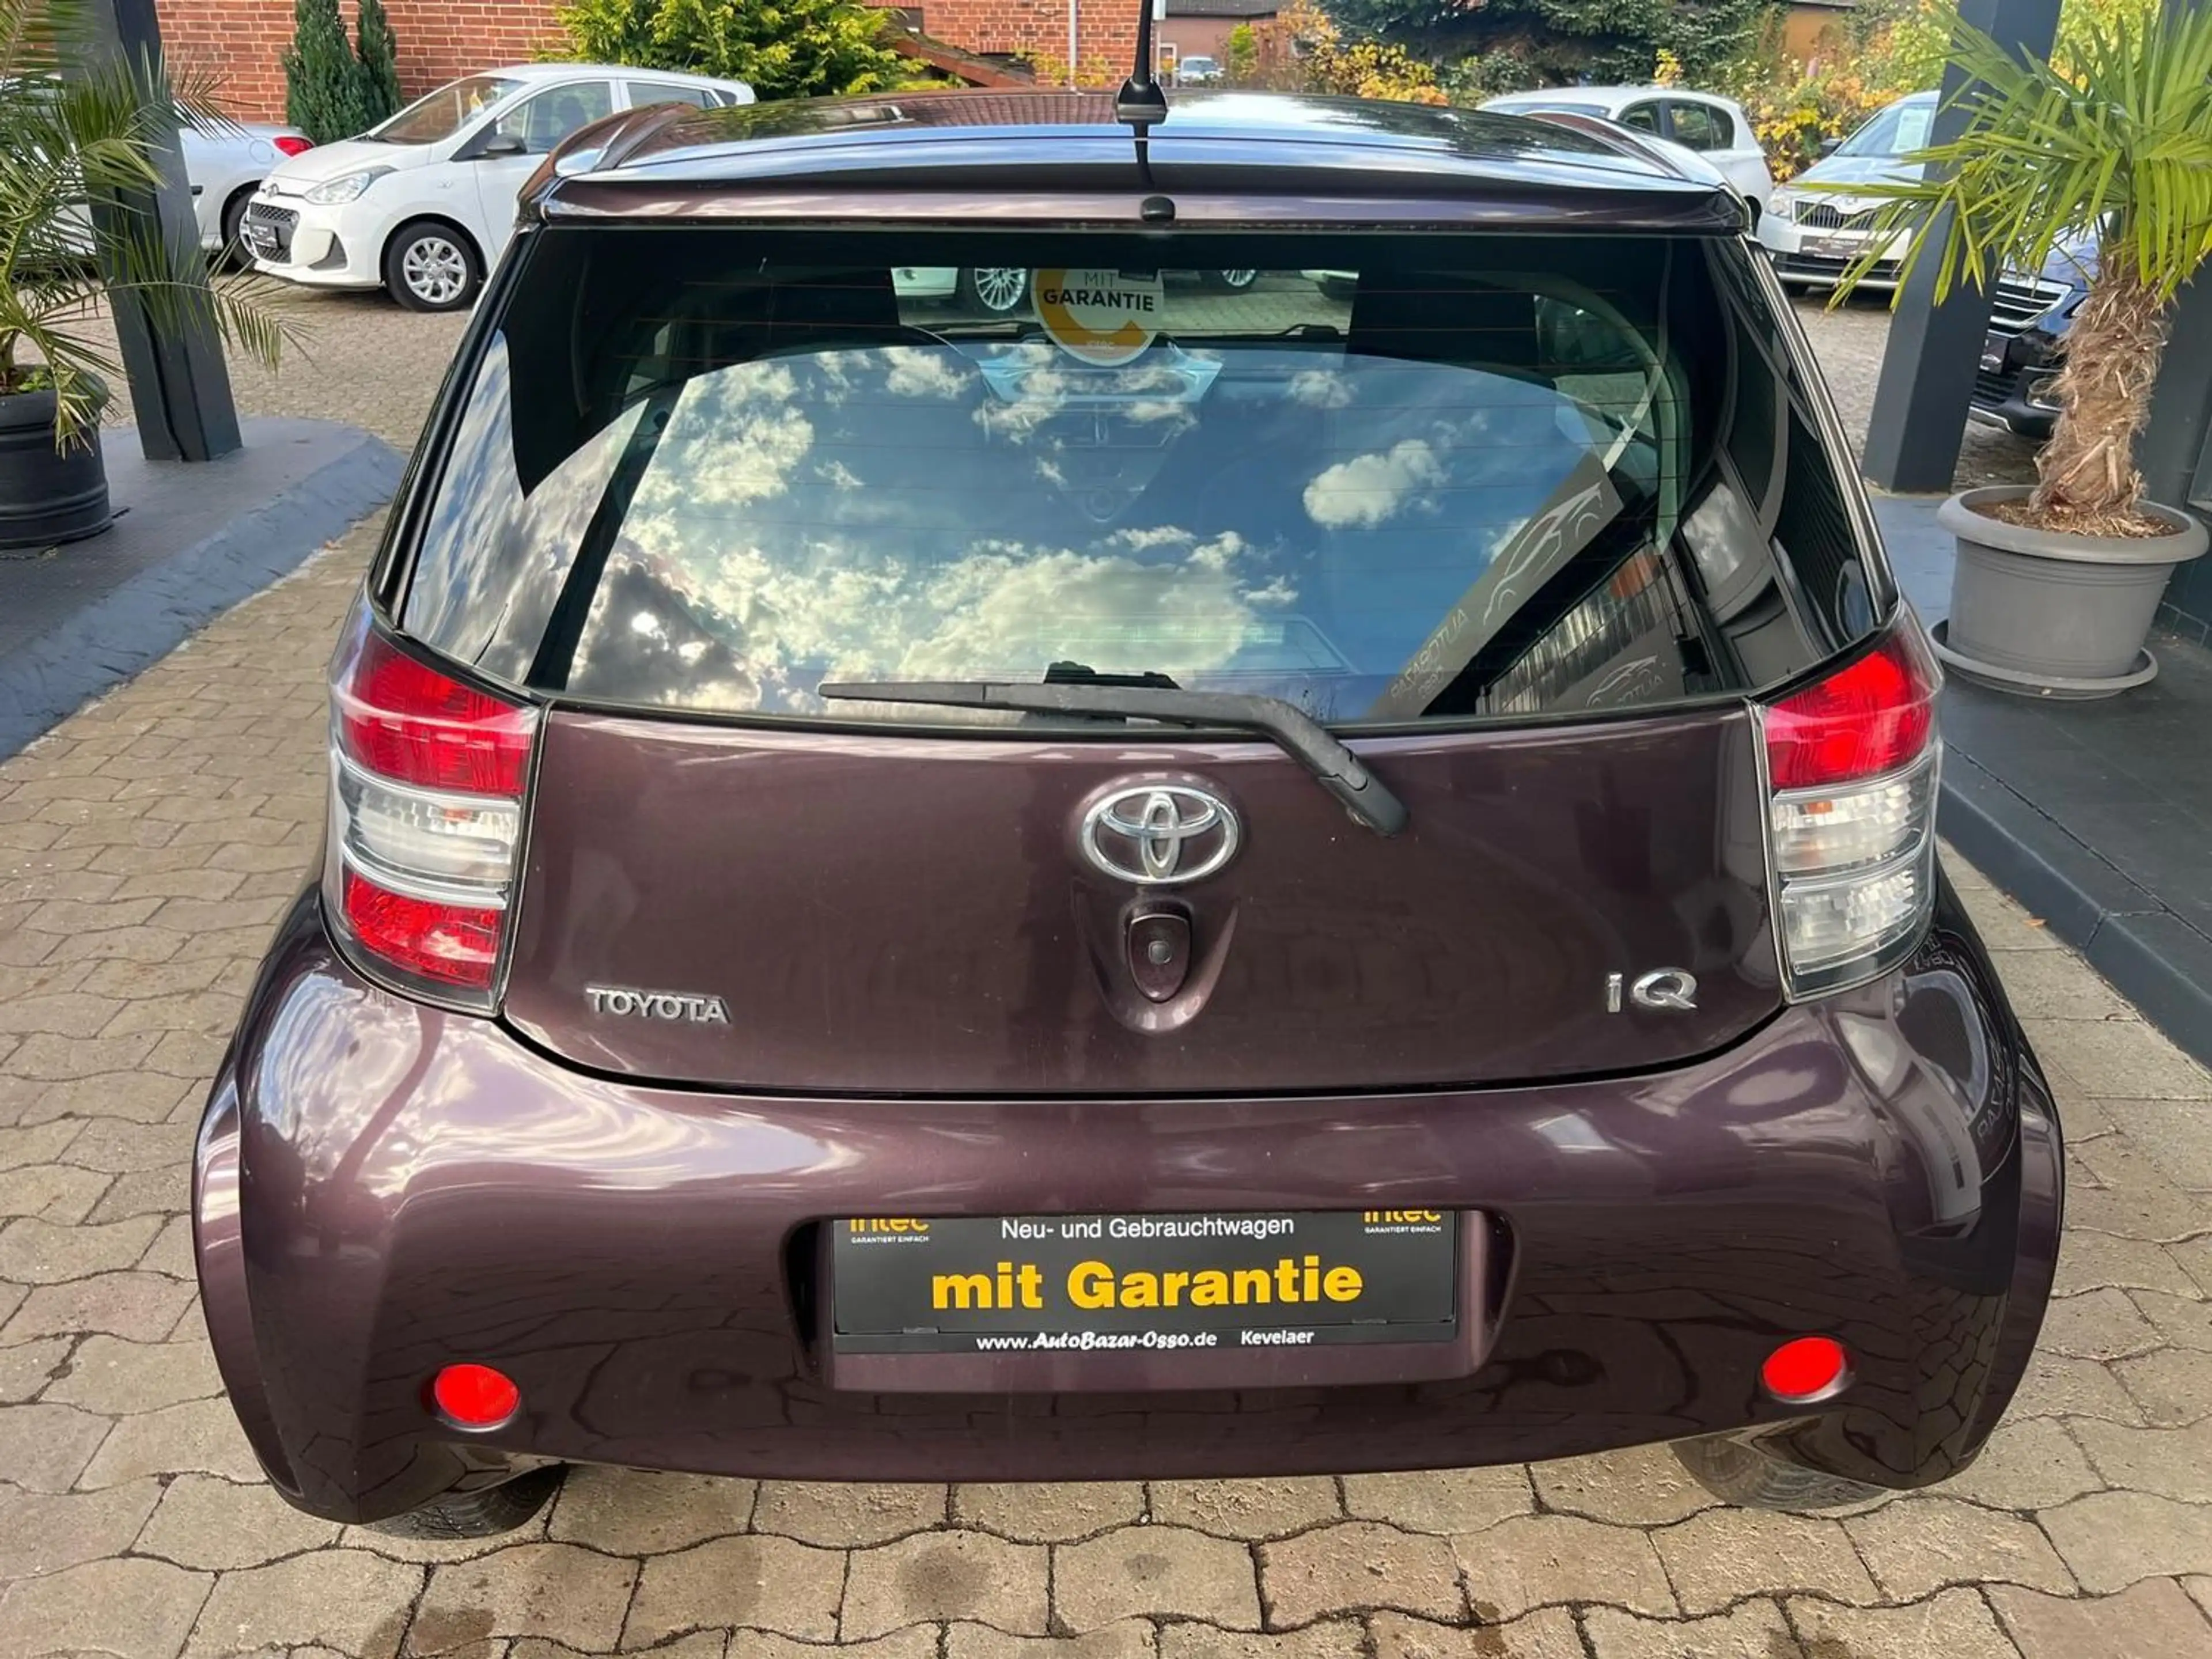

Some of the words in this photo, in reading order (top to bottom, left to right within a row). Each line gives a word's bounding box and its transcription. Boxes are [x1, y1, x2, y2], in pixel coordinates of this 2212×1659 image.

[1084, 271, 1117, 287] MIT
[1043, 289, 1154, 312] GARANTIE
[585, 984, 732, 1024] TOYOTA
[1001, 1218, 1055, 1240] Neu-
[1061, 1218, 1103, 1239] und
[1108, 1216, 1295, 1240] Gebrauchtwagen
[932, 1262, 1043, 1310] mit
[1067, 1254, 1363, 1309] Garantie
[976, 1330, 1218, 1351] www.AutoBazar-Osso.de
[1241, 1329, 1315, 1346] Kevelaer
